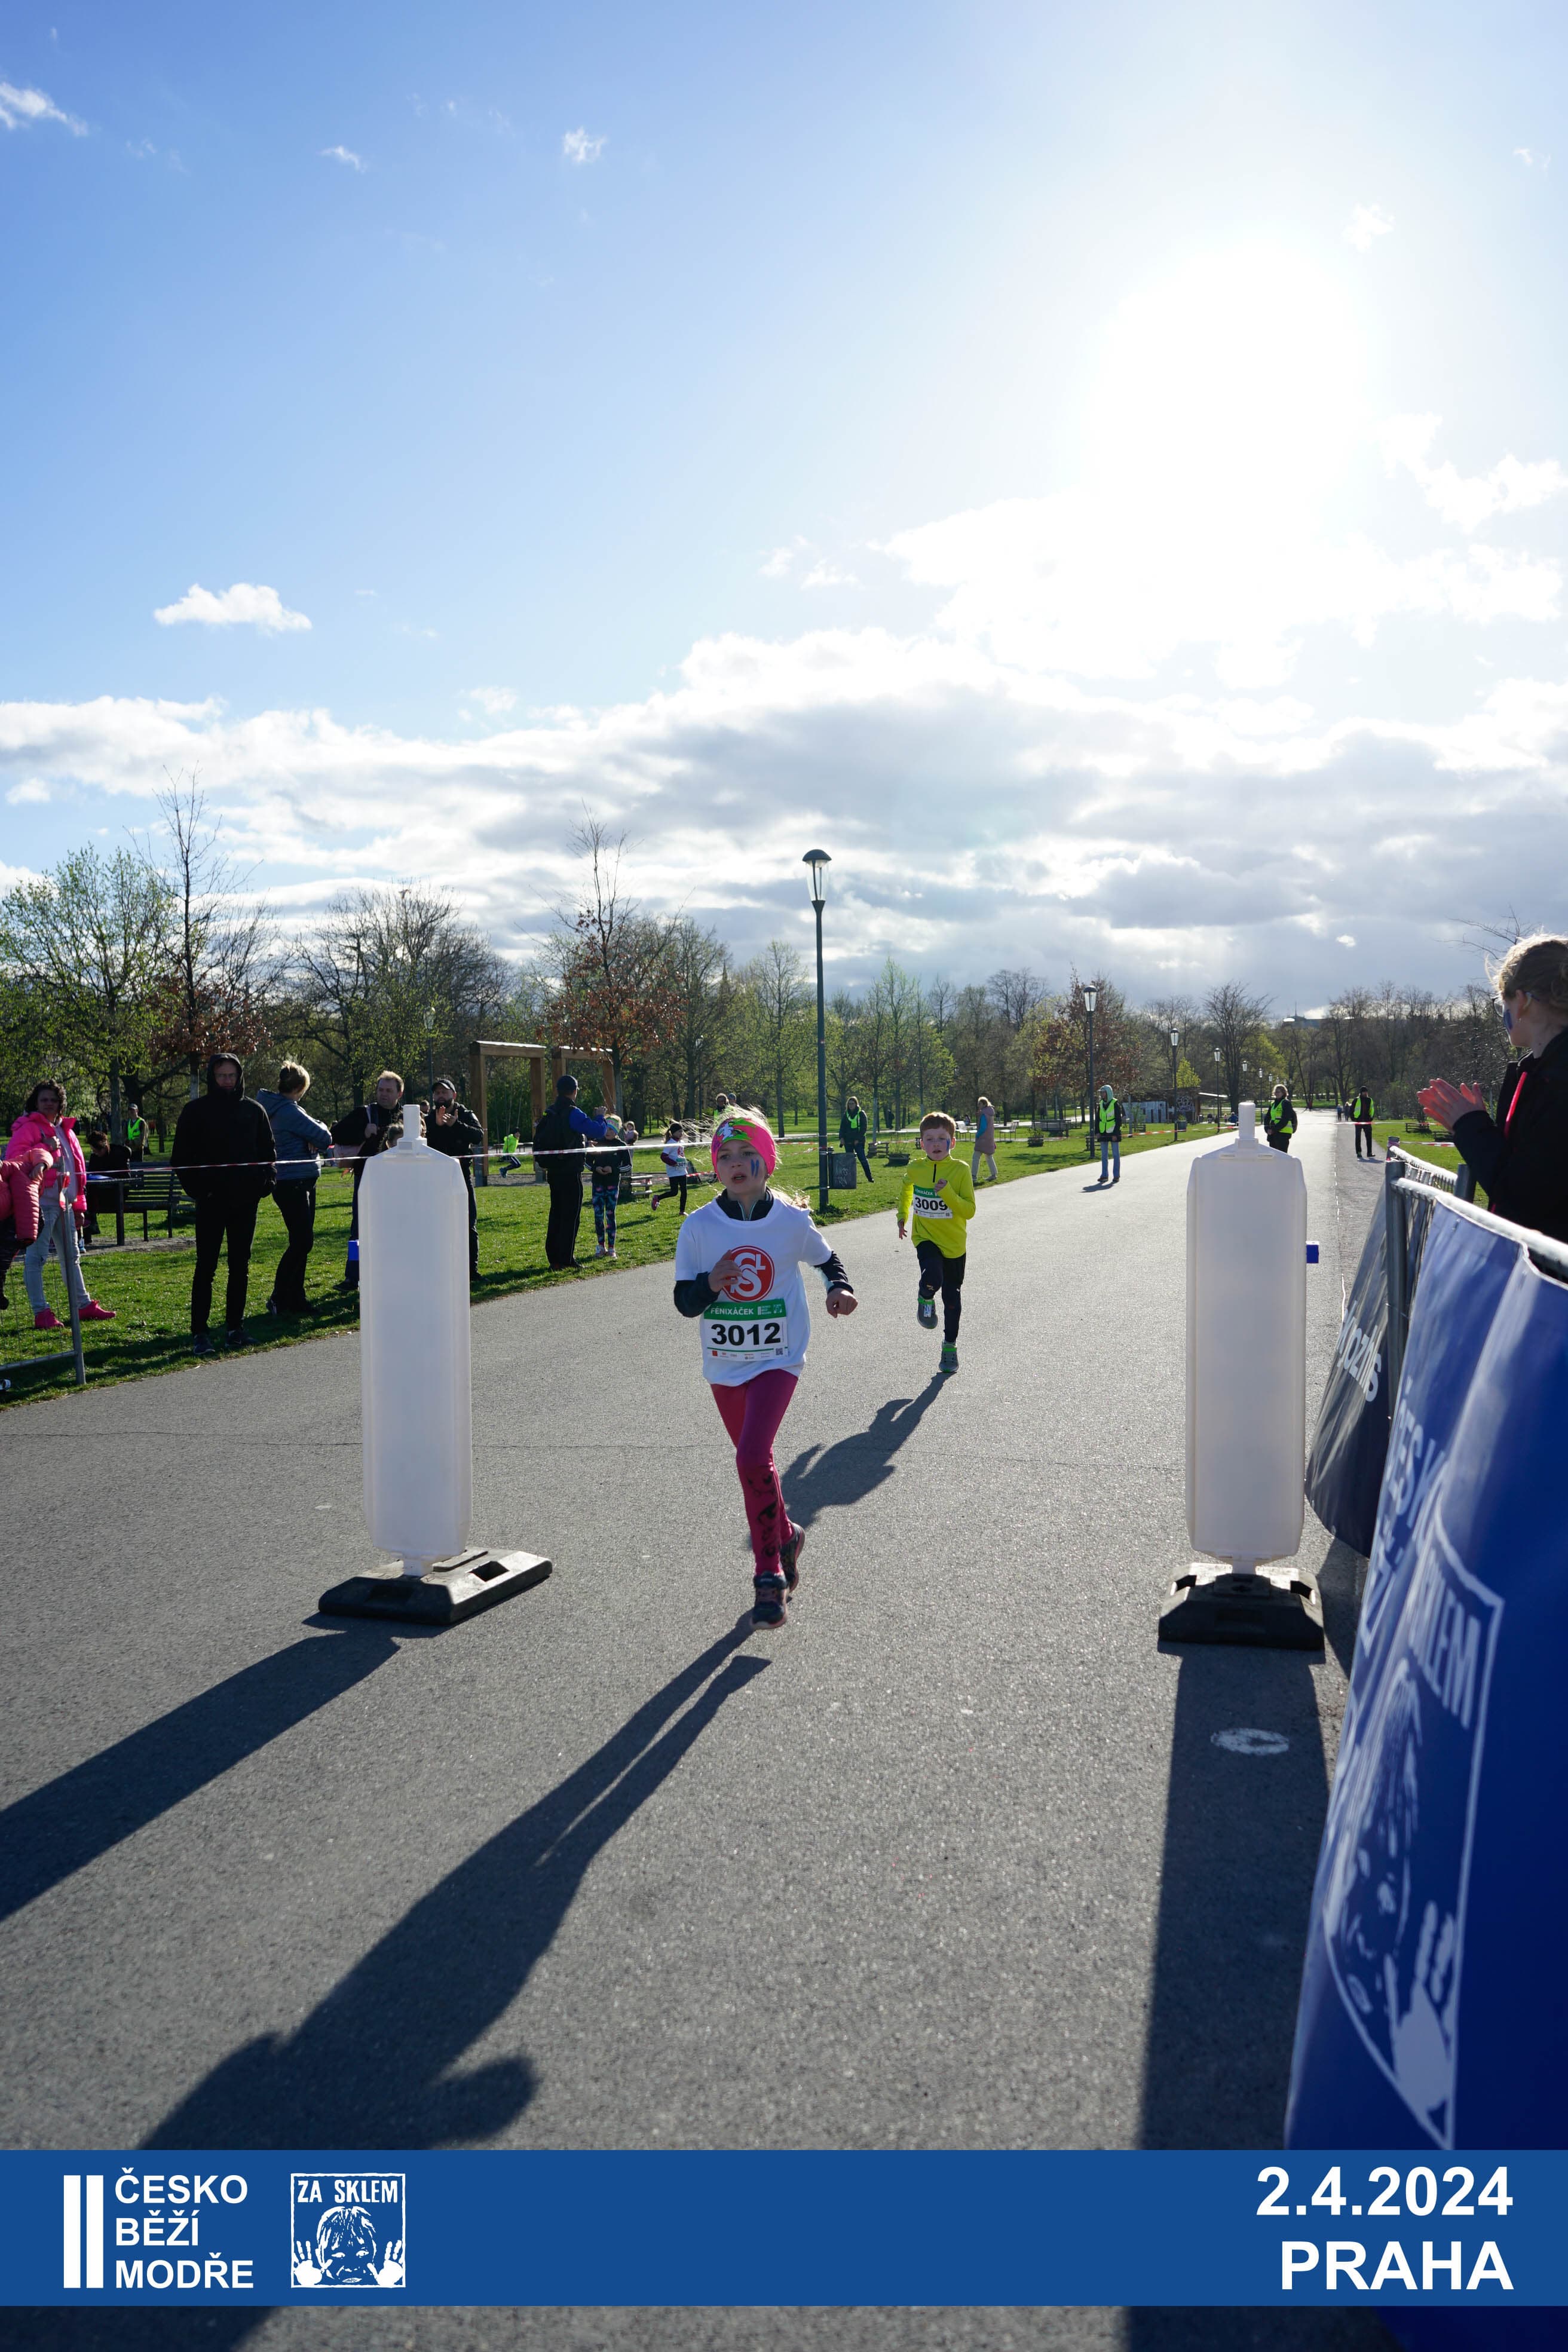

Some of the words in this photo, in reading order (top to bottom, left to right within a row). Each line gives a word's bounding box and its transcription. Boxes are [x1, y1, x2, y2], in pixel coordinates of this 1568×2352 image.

[915, 1197, 948, 1211] 3009
[710, 1306, 754, 1315] FÉNIXÁČEK
[711, 1322, 780, 1346] 3012
[1340, 1324, 1382, 1402] ozhls
